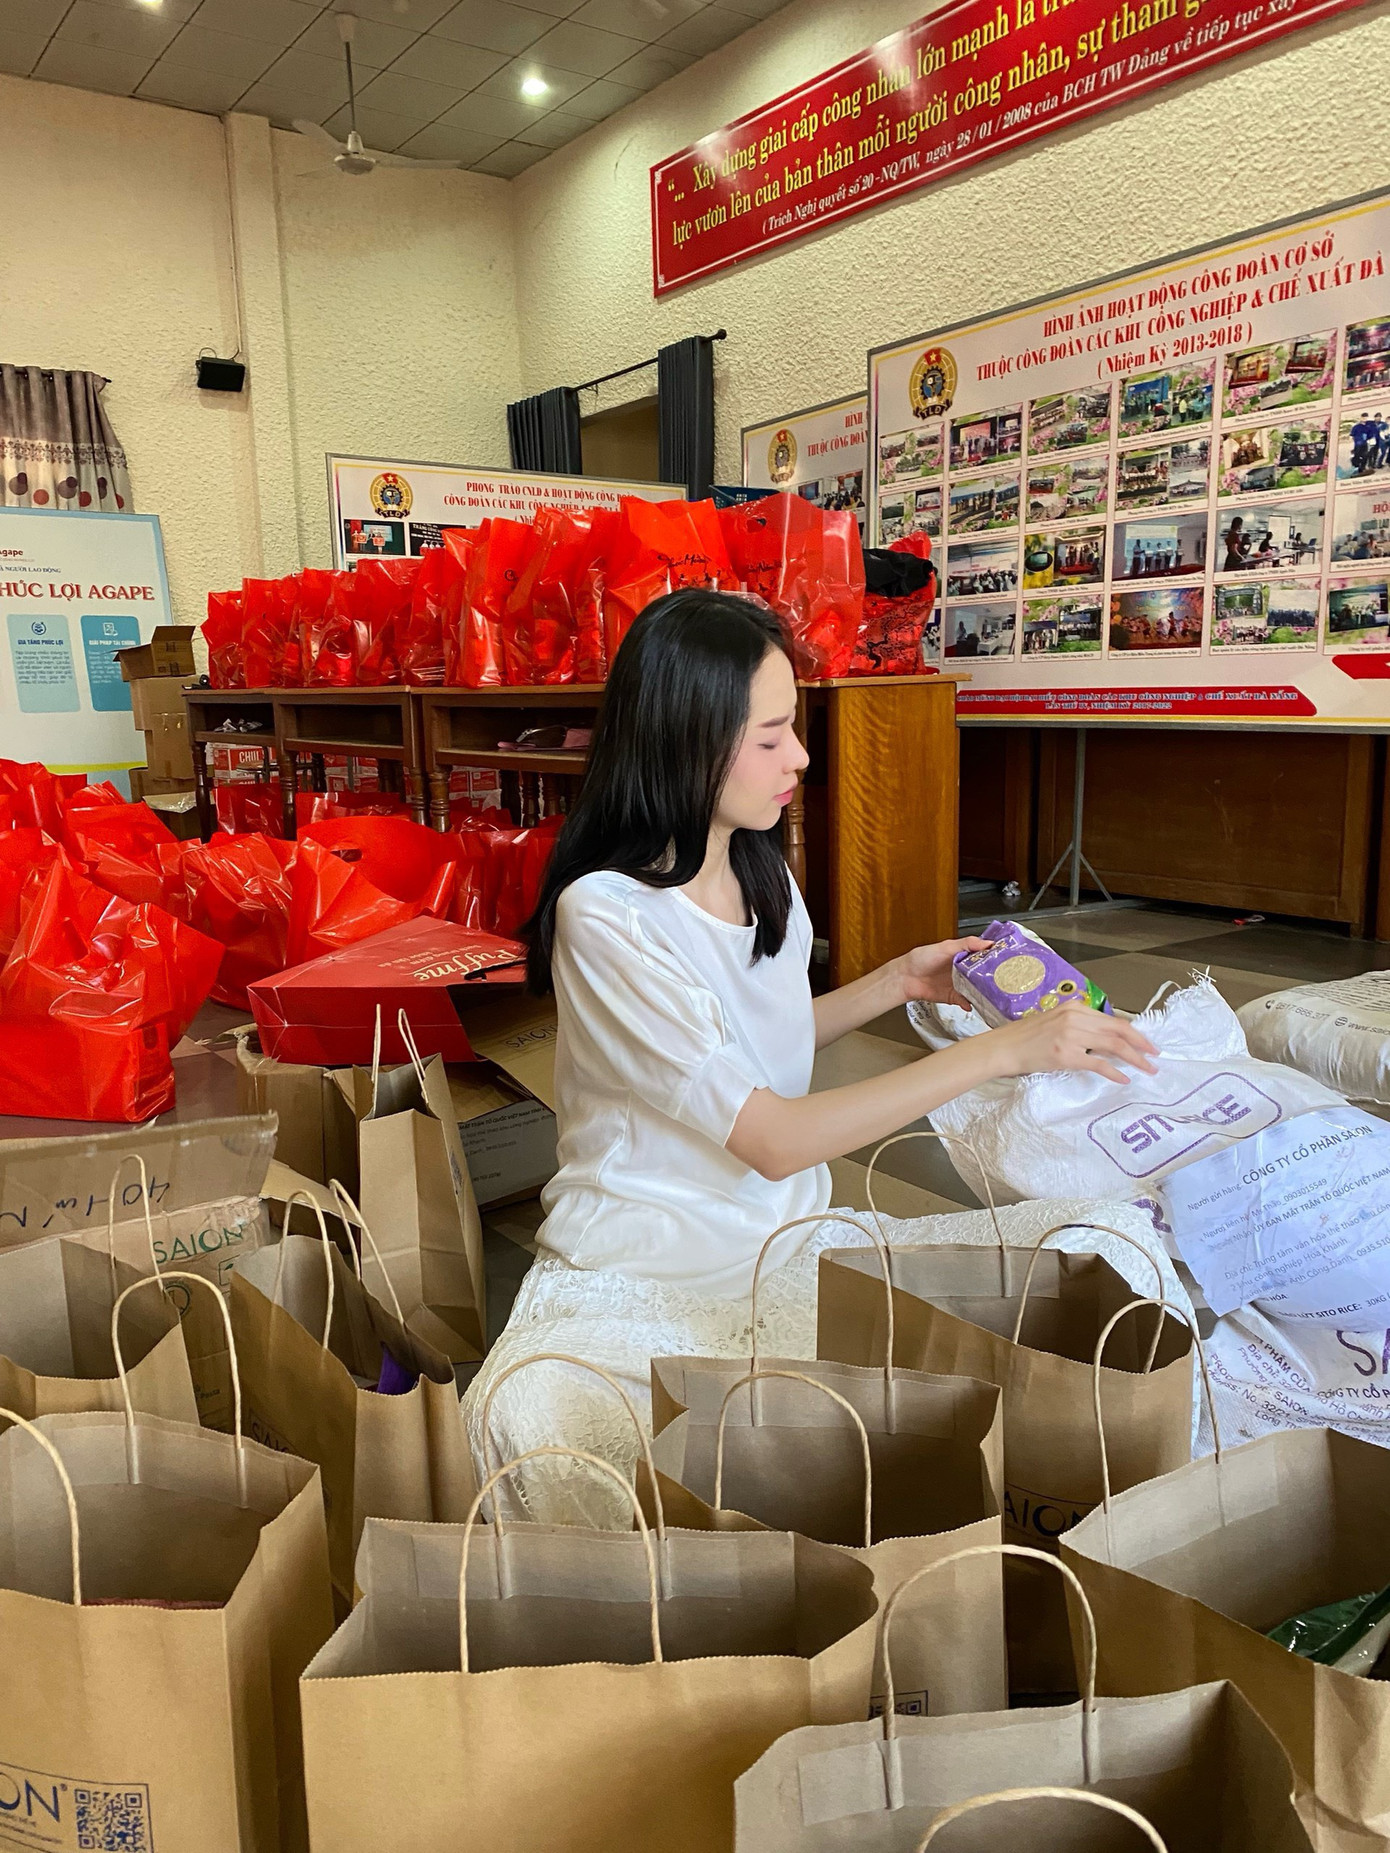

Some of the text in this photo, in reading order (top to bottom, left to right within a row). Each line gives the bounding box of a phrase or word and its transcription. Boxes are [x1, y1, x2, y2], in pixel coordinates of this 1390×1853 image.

[722, 142, 756, 180] dựng
[760, 120, 787, 164] giai
[791, 102, 818, 142] cấp
[823, 92, 862, 119] công
[917, 43, 946, 79] lớn
[951, 5, 1009, 62] mạnh
[794, 198, 817, 221] Nghị
[848, 175, 862, 197] số
[861, 173, 874, 191] 20
[1034, 92, 1059, 116] của
[1062, 72, 1097, 104] BCH
[1100, 58, 1126, 88] TW
[1127, 47, 1171, 76] Đảng
[1173, 27, 1194, 54] về
[1196, 15, 1230, 46] tiếp
[1234, 5, 1264, 31] tục
[673, 220, 692, 250] lực
[695, 205, 727, 234] vươn
[730, 190, 752, 219] lên
[755, 173, 781, 207] của
[784, 158, 813, 194] bản
[817, 142, 854, 179] thân
[858, 114, 890, 160] mỗi
[896, 91, 948, 144] người
[954, 77, 1003, 107] công
[1007, 42, 1070, 92] nhân,
[1077, 18, 1106, 63] sự
[1043, 230, 1335, 338] HÌNH ẢNH HOẠT ĐỘNG CÔNG ĐOÀN CƠ SỞ
[976, 250, 1385, 381] THUỘC CÔNG ĐOÀN CÁC KHU CÔNG NGHIỆP & CHẾ XUẤT ĐÀ
[1106, 324, 1243, 375] Nhiệm Kỳ 2013-2018
[845, 411, 863, 428] HÌNH
[807, 434, 848, 457] THUỘC CÔNG
[444, 493, 466, 506] CÔNG
[468, 495, 491, 507] ĐOÀN
[493, 497, 507, 509] CÁC
[509, 499, 525, 511] KHU
[466, 482, 494, 494] PHONG
[499, 483, 521, 495] TRÀO
[551, 488, 573, 500] HOẠT
[574, 488, 594, 501] ĐỘNG
[596, 490, 619, 502] CÔNG
[48, 583, 83, 601] LỢI
[88, 584, 155, 601] AGAPE
[1187, 1197, 1210, 1211] Người
[1242, 1162, 1276, 1185] CÔNG
[1275, 1154, 1290, 1169] TY
[1292, 1143, 1310, 1162] CỔ
[1309, 1134, 1342, 1153] PHẦN
[1265, 1215, 1282, 1228] BAN
[1300, 1197, 1321, 1212] TRẬN
[1332, 1182, 1356, 1197] QUỐC
[1354, 1174, 1371, 1188] VIỆT
[1371, 1167, 1390, 1179] NAM
[153, 1224, 243, 1264] SAION
[1254, 1255, 1277, 1269] Trung
[1274, 1258, 1303, 1274] nghiệp
[1316, 1295, 1387, 1319] SITO RICE: 30KG
[1346, 1387, 1361, 1398] TY
[1362, 1382, 1381, 1399] CỔ
